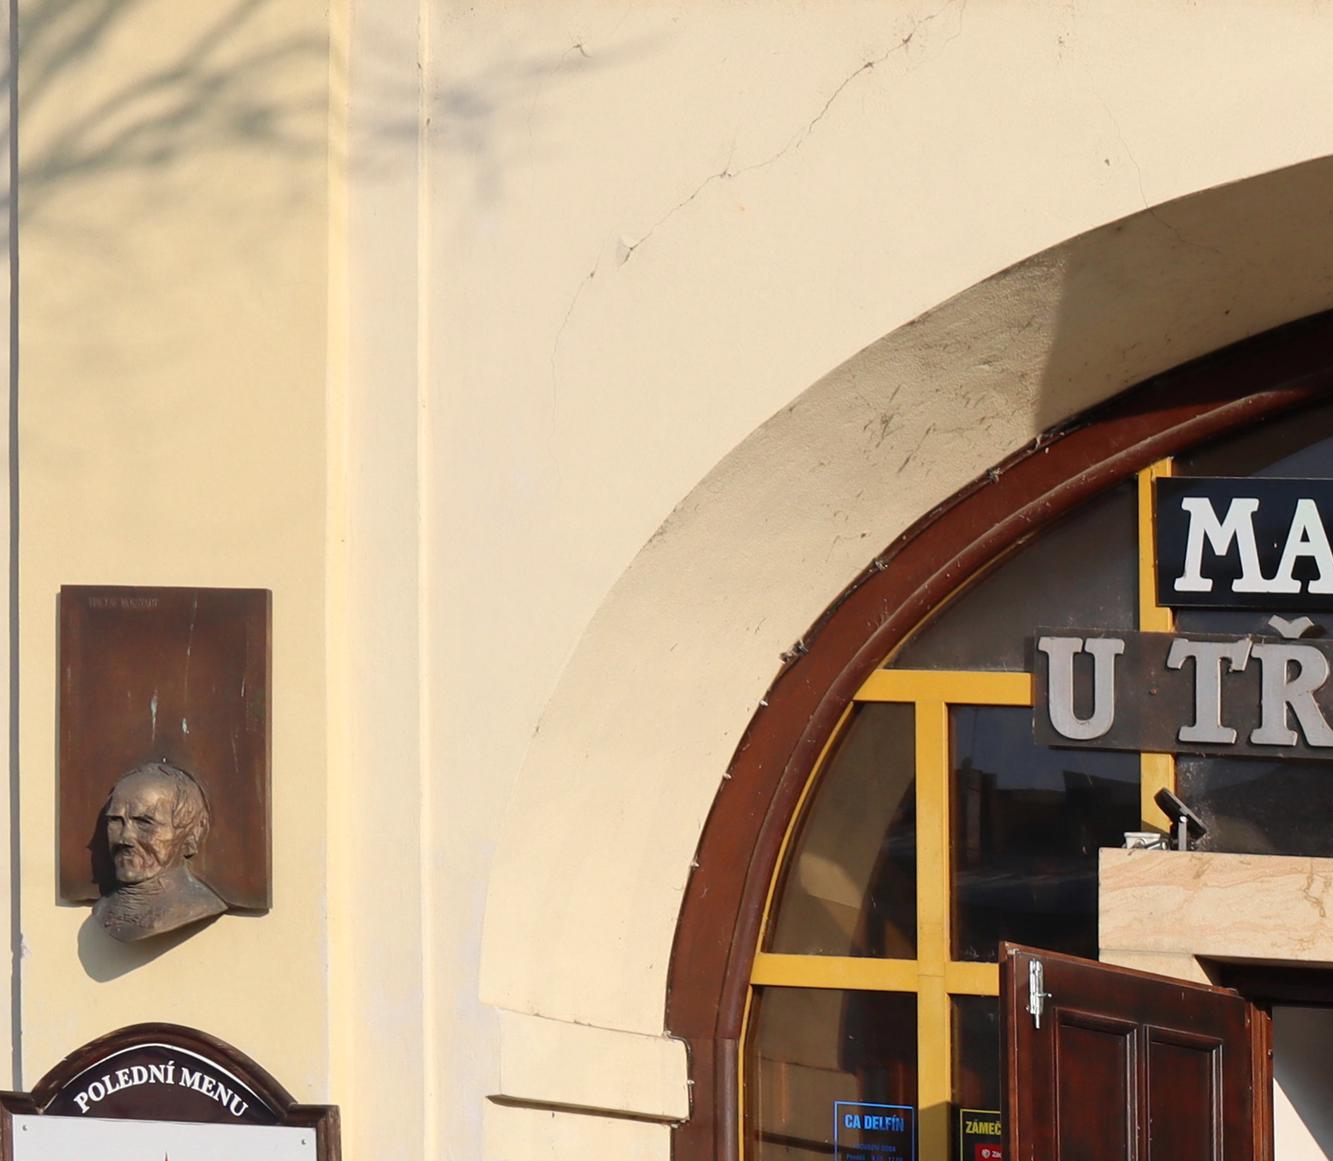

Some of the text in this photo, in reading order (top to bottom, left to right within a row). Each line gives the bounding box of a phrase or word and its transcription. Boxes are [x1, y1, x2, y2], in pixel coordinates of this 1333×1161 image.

[1036, 637, 1127, 742] U
[74, 1060, 249, 1117] POLEDNÍ MENU
[844, 1114, 861, 1129] CA
[966, 1119, 1001, 1135] ZÁMEČ
